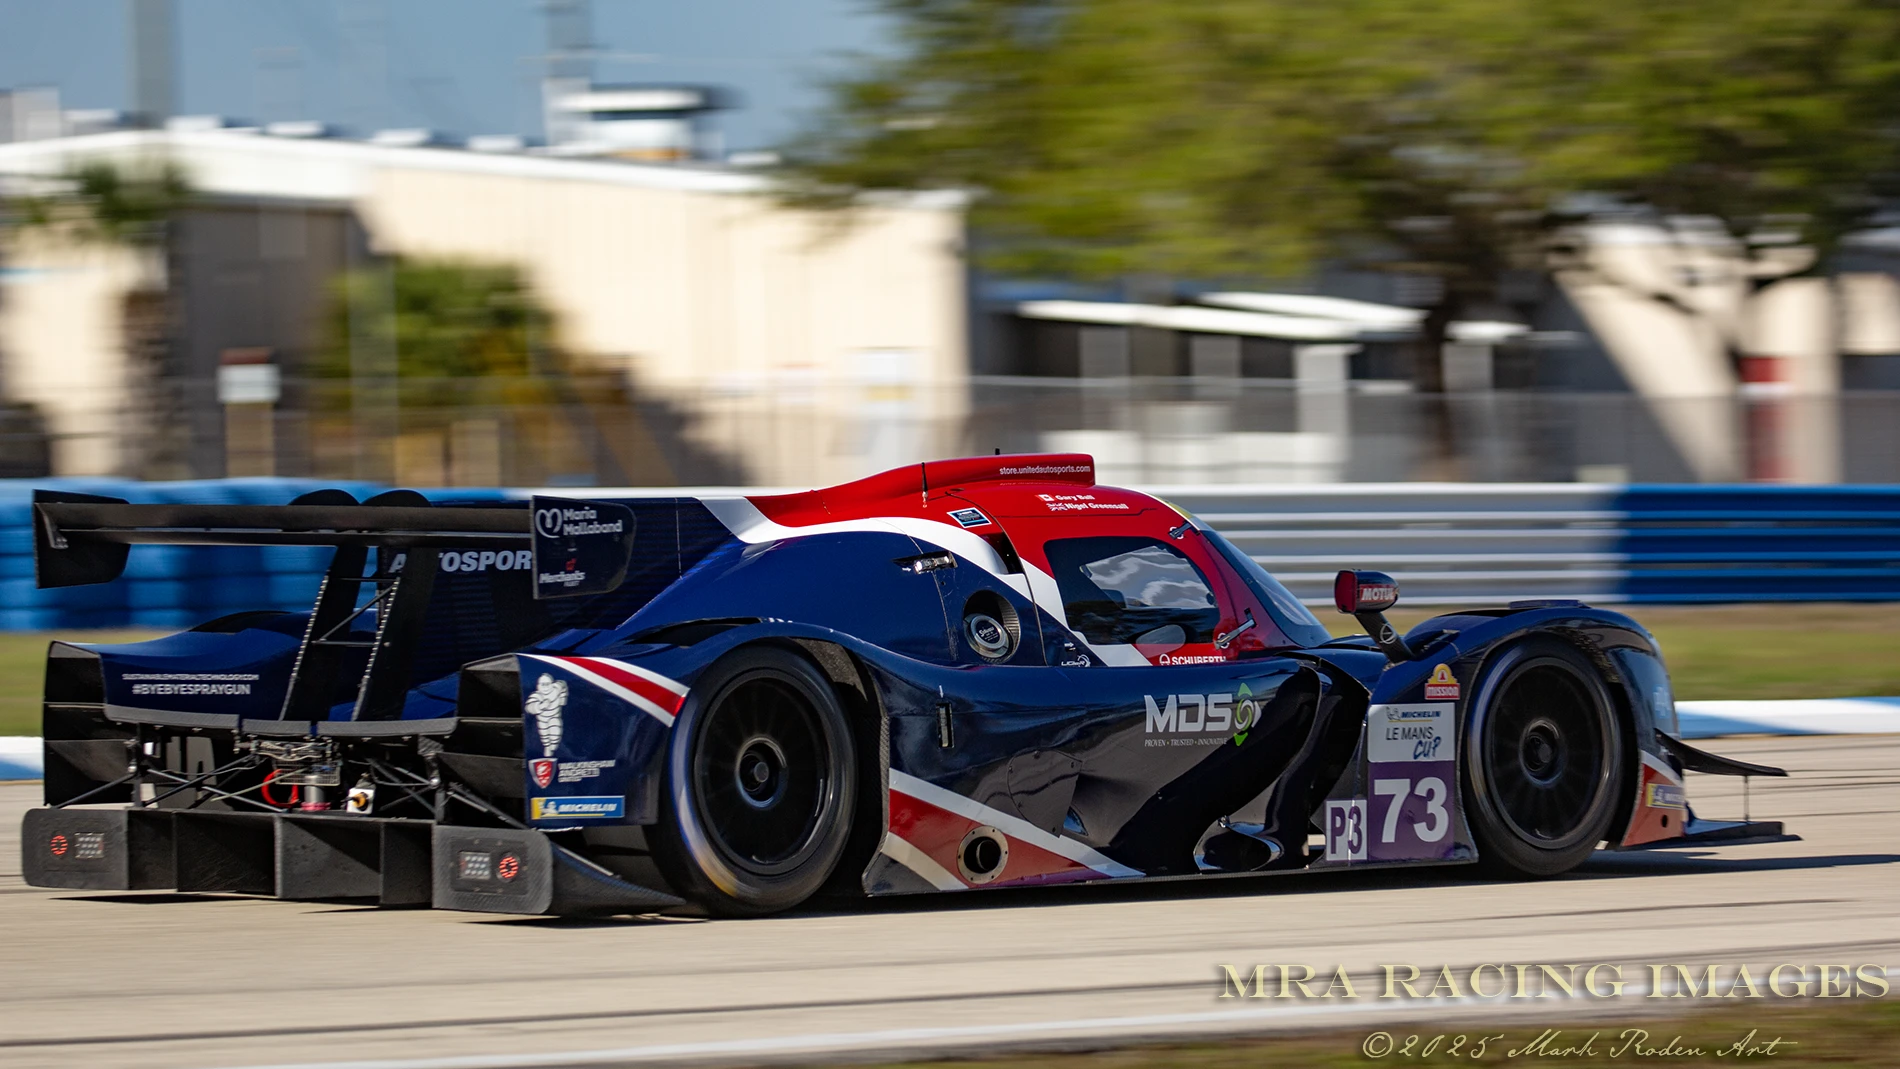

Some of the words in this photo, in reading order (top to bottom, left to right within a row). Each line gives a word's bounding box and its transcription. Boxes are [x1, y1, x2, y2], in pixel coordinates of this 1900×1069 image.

[999, 465, 1091, 476] store.unitedautosports.com
[1055, 494, 1077, 502] Gary
[562, 506, 597, 520] Maria
[1066, 502, 1088, 510] Nigel
[562, 519, 623, 536] Mallaband
[388, 550, 533, 573] AOSPOR
[539, 570, 585, 584] Merchants
[1361, 587, 1395, 601] MOTUL
[1171, 655, 1227, 665] SCHUBERTH
[131, 683, 251, 695] #BYEBYESPRAYGUN
[1143, 693, 1233, 733] MDS
[1386, 727, 1399, 740] LE
[1401, 726, 1434, 740] MANS
[1144, 739, 1167, 747] PROVEN
[1170, 738, 1194, 747] TRUSTED
[1413, 736, 1442, 760] CUP
[557, 803, 618, 813] MICHELIN
[1373, 776, 1450, 843] 73
[1330, 805, 1363, 855] P3
